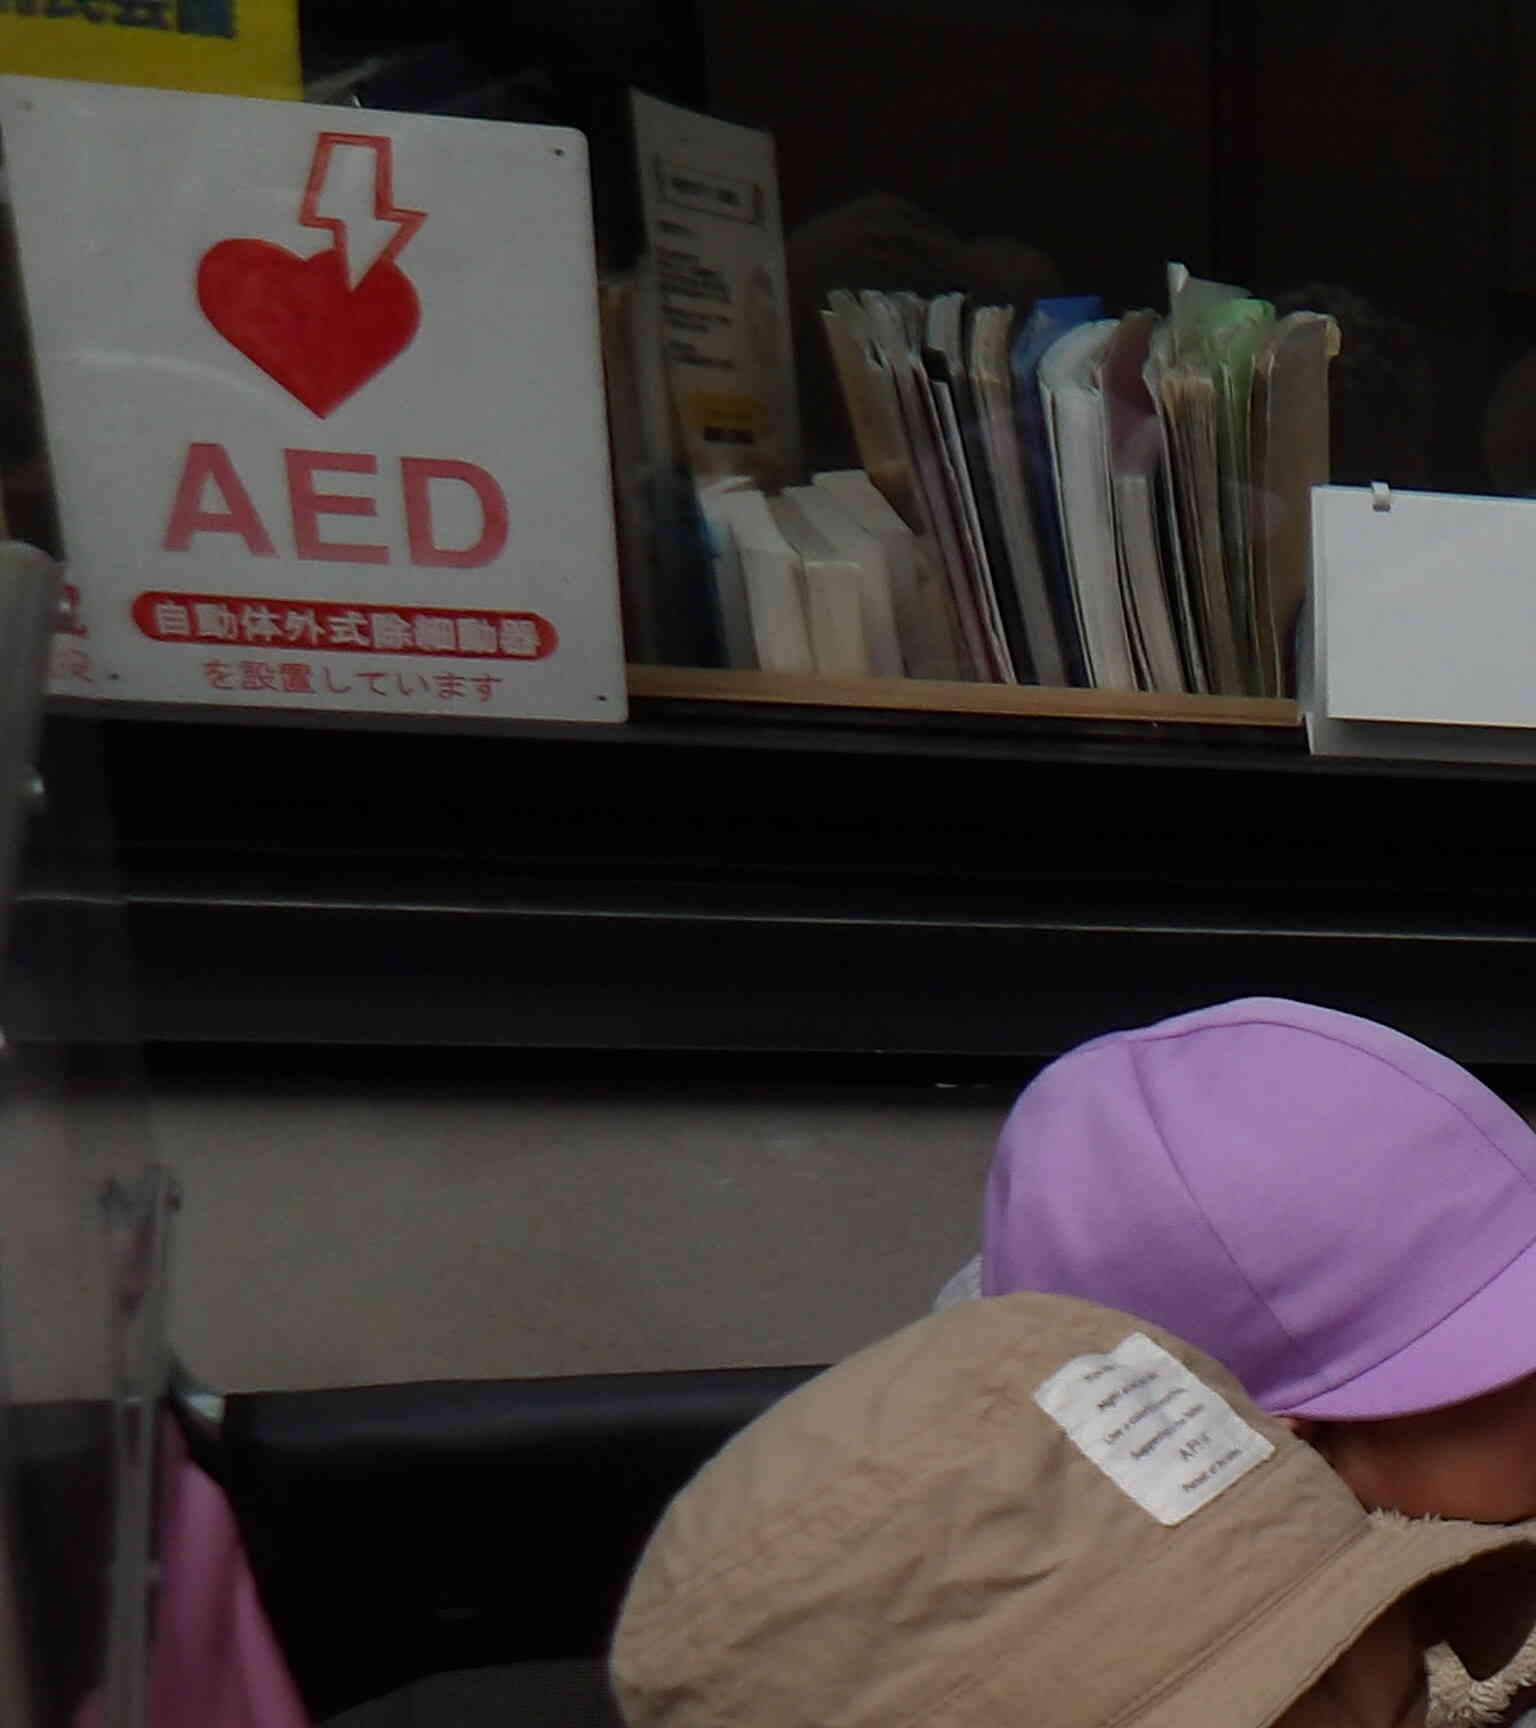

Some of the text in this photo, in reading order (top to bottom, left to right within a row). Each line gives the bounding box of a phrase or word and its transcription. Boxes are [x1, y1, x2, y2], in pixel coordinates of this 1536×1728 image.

[162, 442, 509, 568] AED
[153, 599, 543, 657] 自動体外式除細動器
[203, 659, 503, 702] を設置しています
